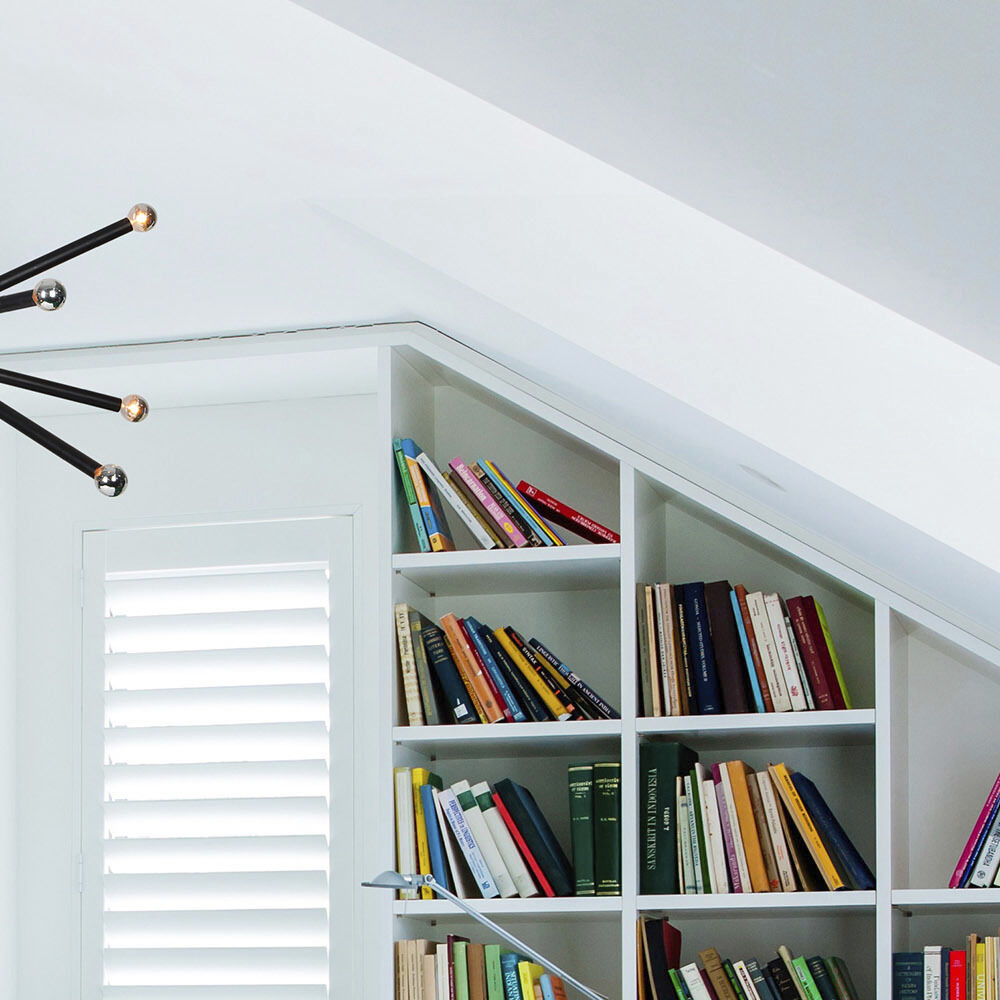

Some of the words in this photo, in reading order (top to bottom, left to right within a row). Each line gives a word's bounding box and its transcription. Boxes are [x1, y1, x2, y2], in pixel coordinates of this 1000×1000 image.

[455, 462, 489, 502] Reincarnation
[521, 646, 536, 665] SYNTAX
[581, 686, 599, 704] ANCIENT
[598, 701, 611, 714] INDIA
[646, 767, 658, 813] INDONESIA
[647, 814, 656, 825] IN
[646, 826, 656, 869] SANSKRIT
[504, 971, 514, 997] INDIAN
